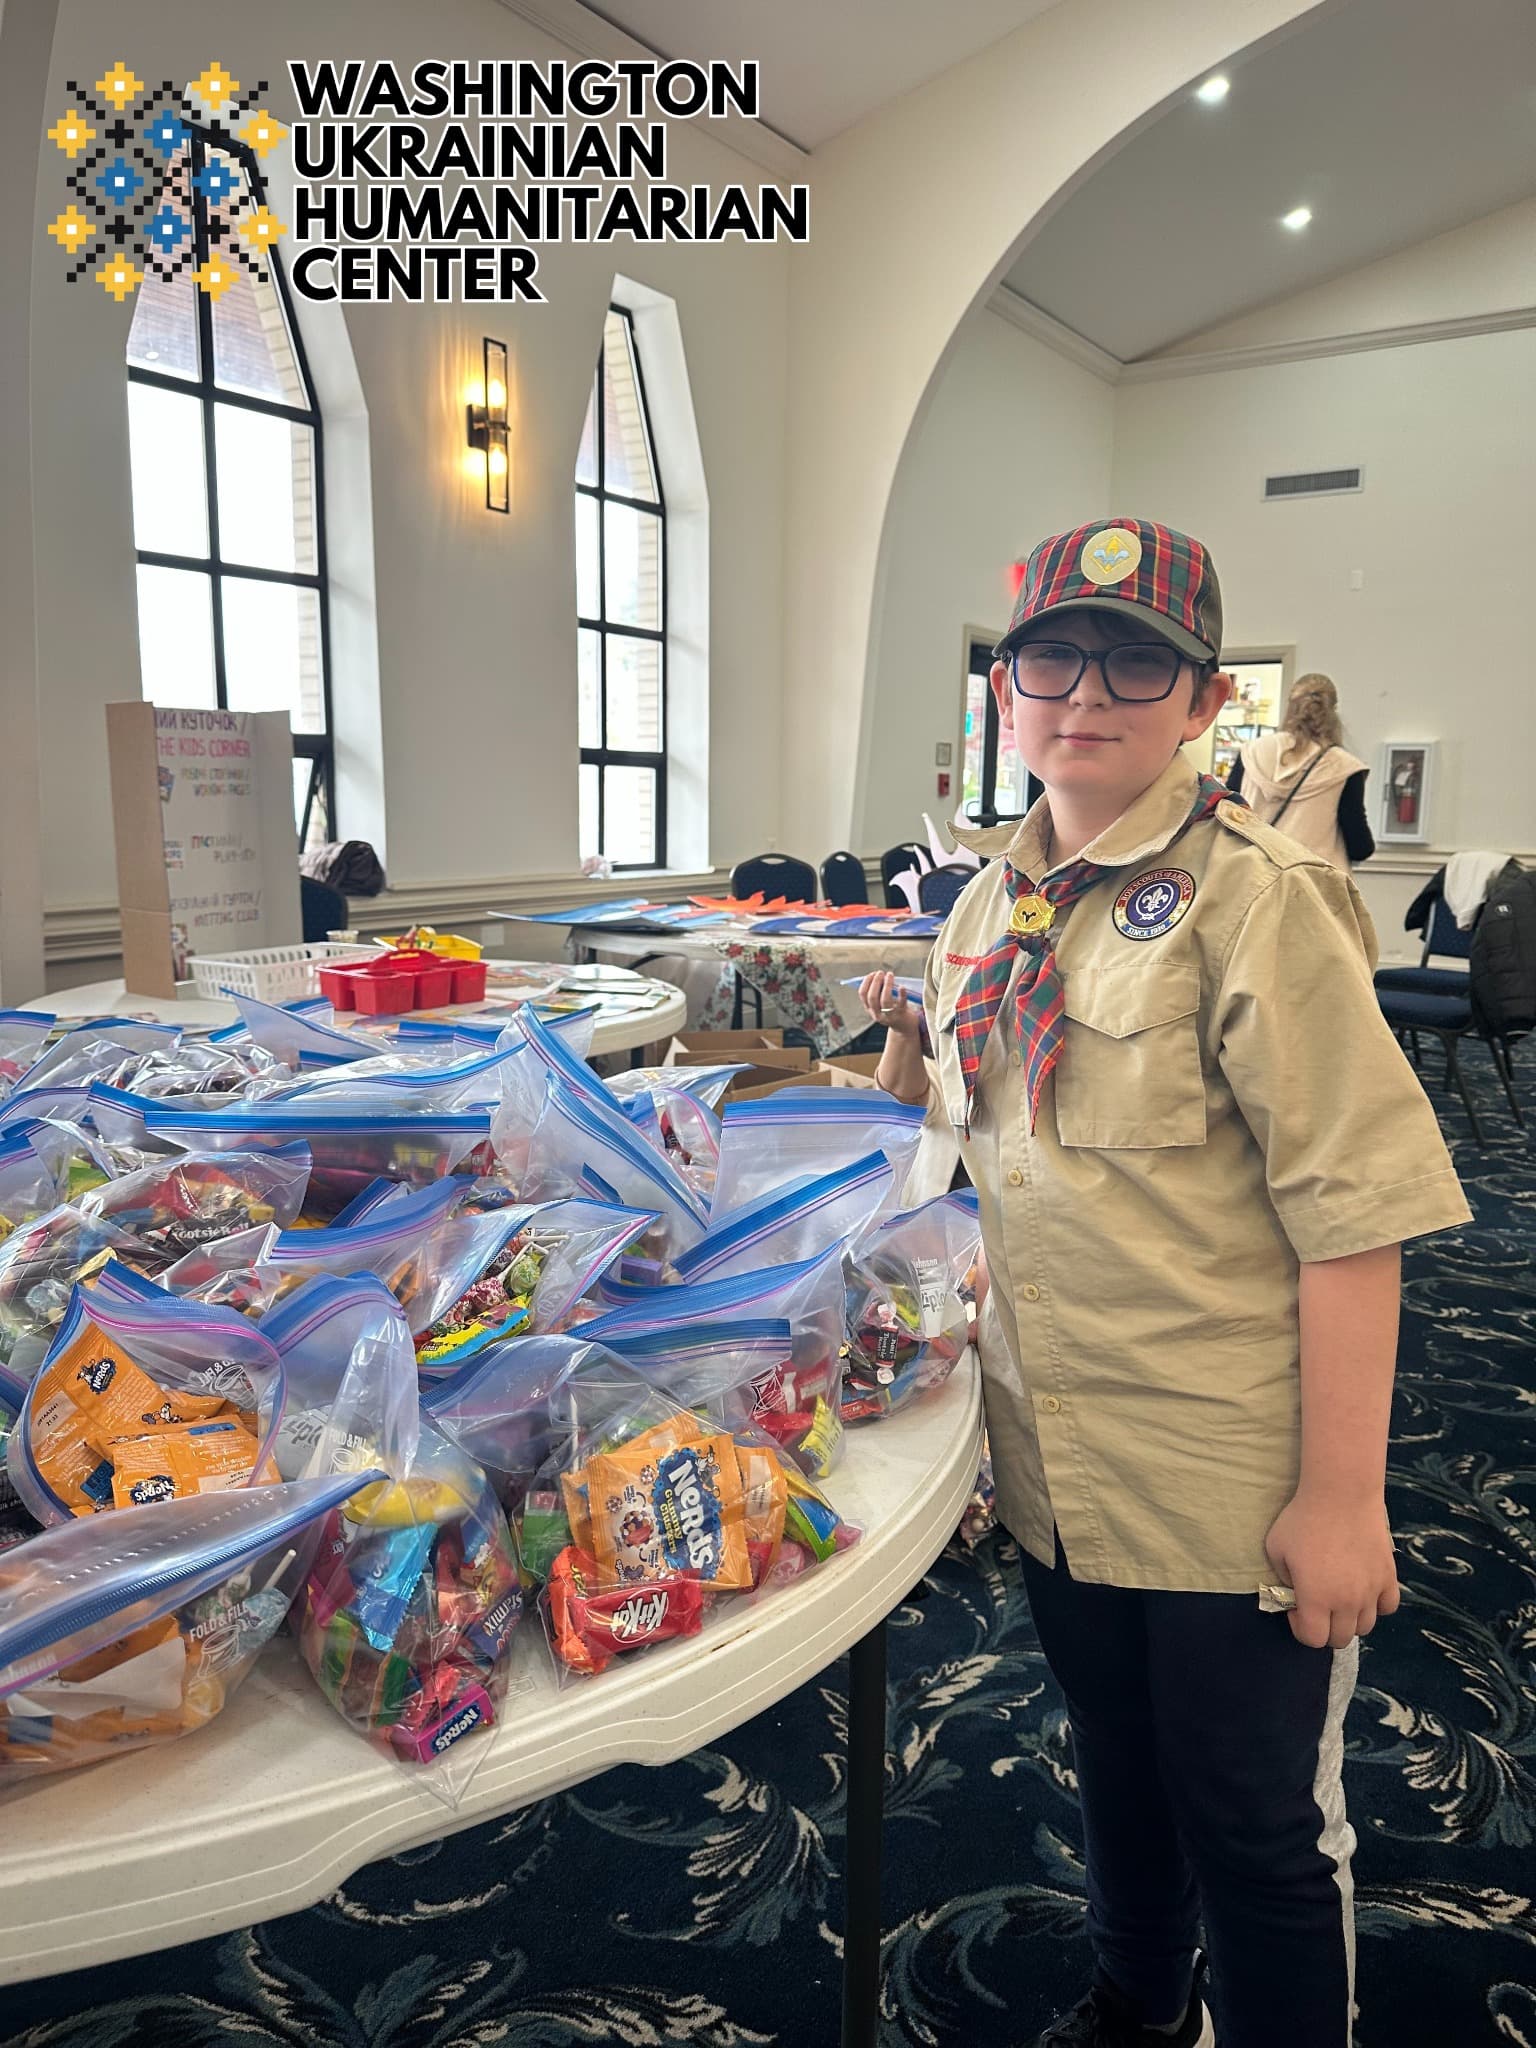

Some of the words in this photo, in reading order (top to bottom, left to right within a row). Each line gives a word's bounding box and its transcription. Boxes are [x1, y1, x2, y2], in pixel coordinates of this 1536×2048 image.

[179, 737, 206, 757] KIDS
[208, 738, 251, 759] CORNER
[1133, 871, 1163, 890] SCOUTS
[1127, 926, 1149, 937] SINCE
[660, 1503, 678, 1554] Clusters
[664, 1488, 683, 1540] Gummy
[190, 1617, 217, 1642] FOLD
[227, 1601, 249, 1622] FILL
